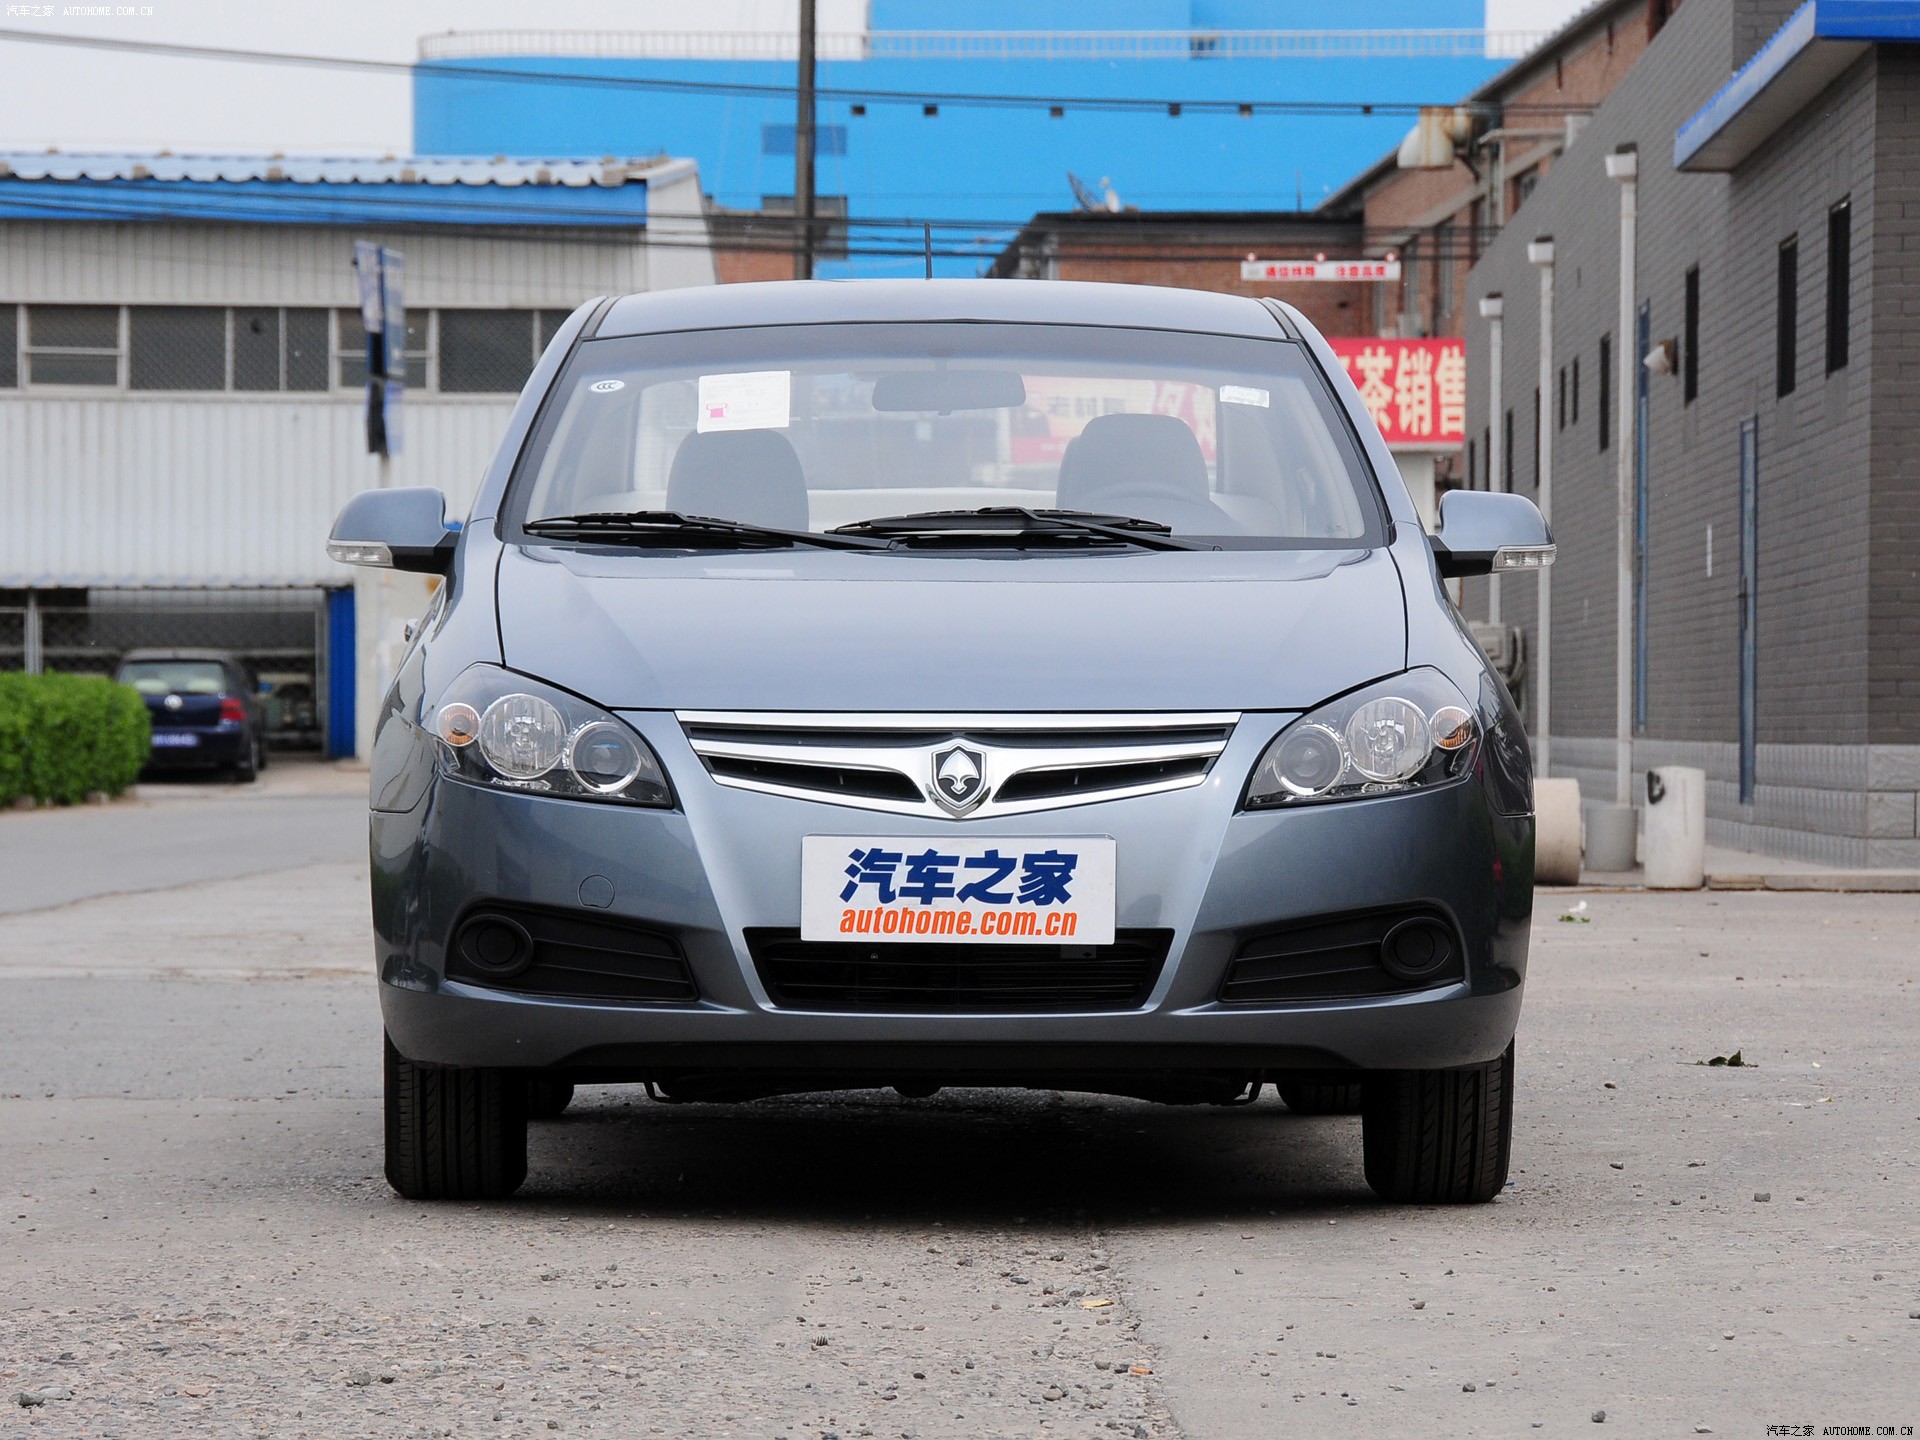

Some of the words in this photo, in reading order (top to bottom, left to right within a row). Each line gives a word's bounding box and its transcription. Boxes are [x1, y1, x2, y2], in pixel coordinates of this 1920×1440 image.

[1337, 345, 1466, 435] 茶销售
[839, 848, 1078, 905] 汽车之家
[839, 906, 1077, 936] autohome.com.cn
